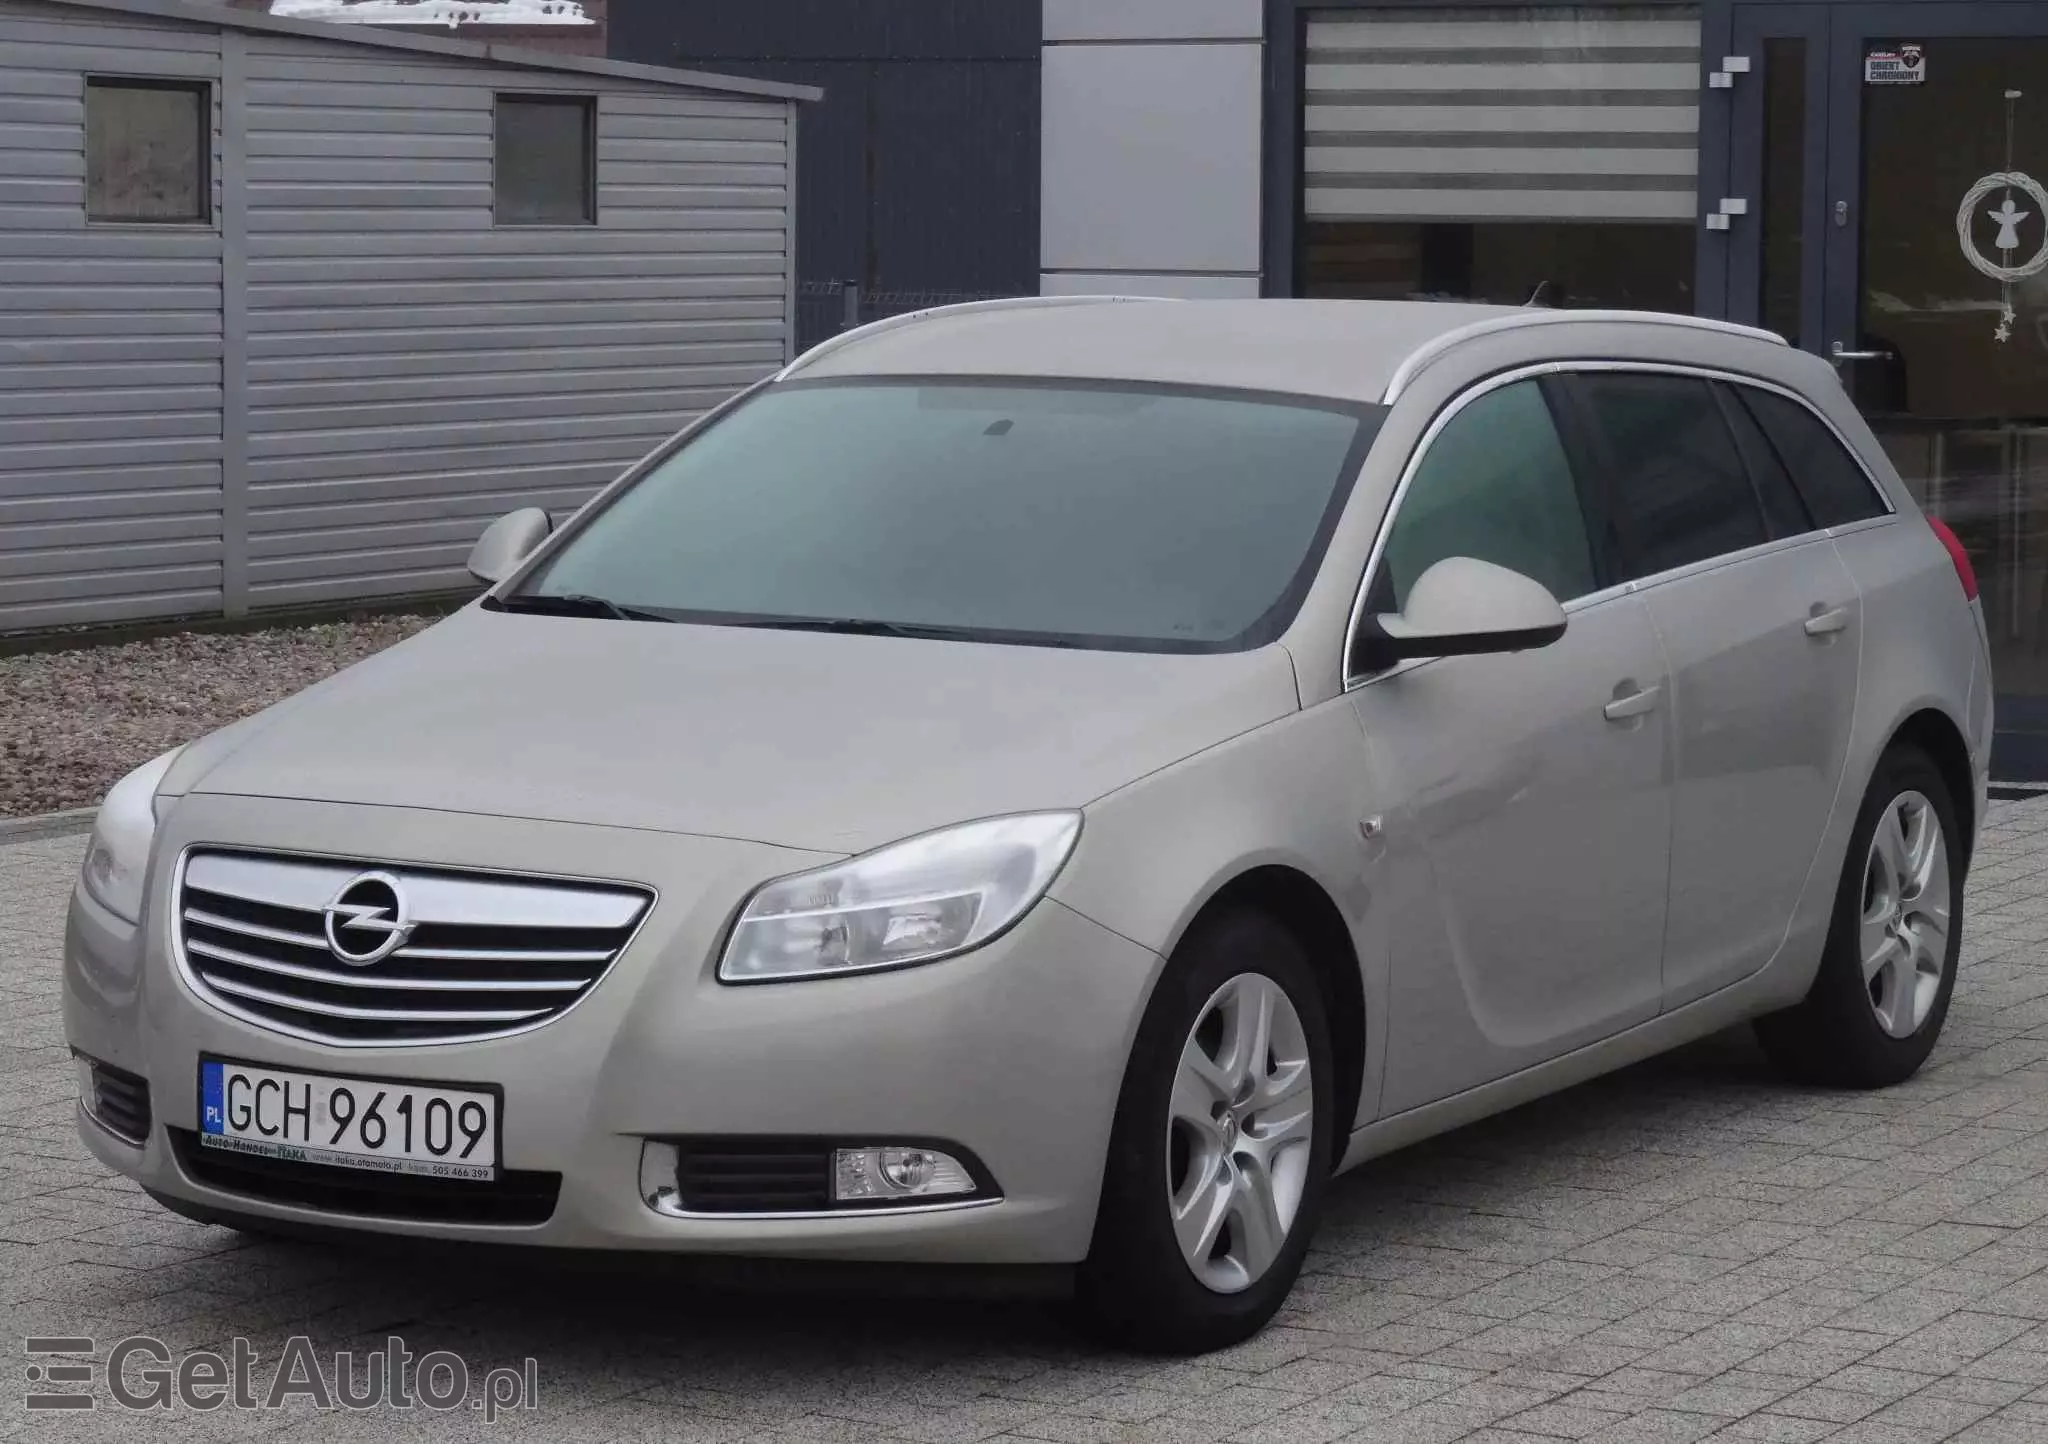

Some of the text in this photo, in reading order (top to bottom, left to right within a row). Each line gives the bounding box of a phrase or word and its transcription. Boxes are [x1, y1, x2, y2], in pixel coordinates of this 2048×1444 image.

[206, 1107, 222, 1124] PL
[227, 1074, 487, 1159] GCH 96109
[432, 1166, 449, 1176] 505
[451, 1167, 469, 1177] 466
[472, 1169, 489, 1179] 399
